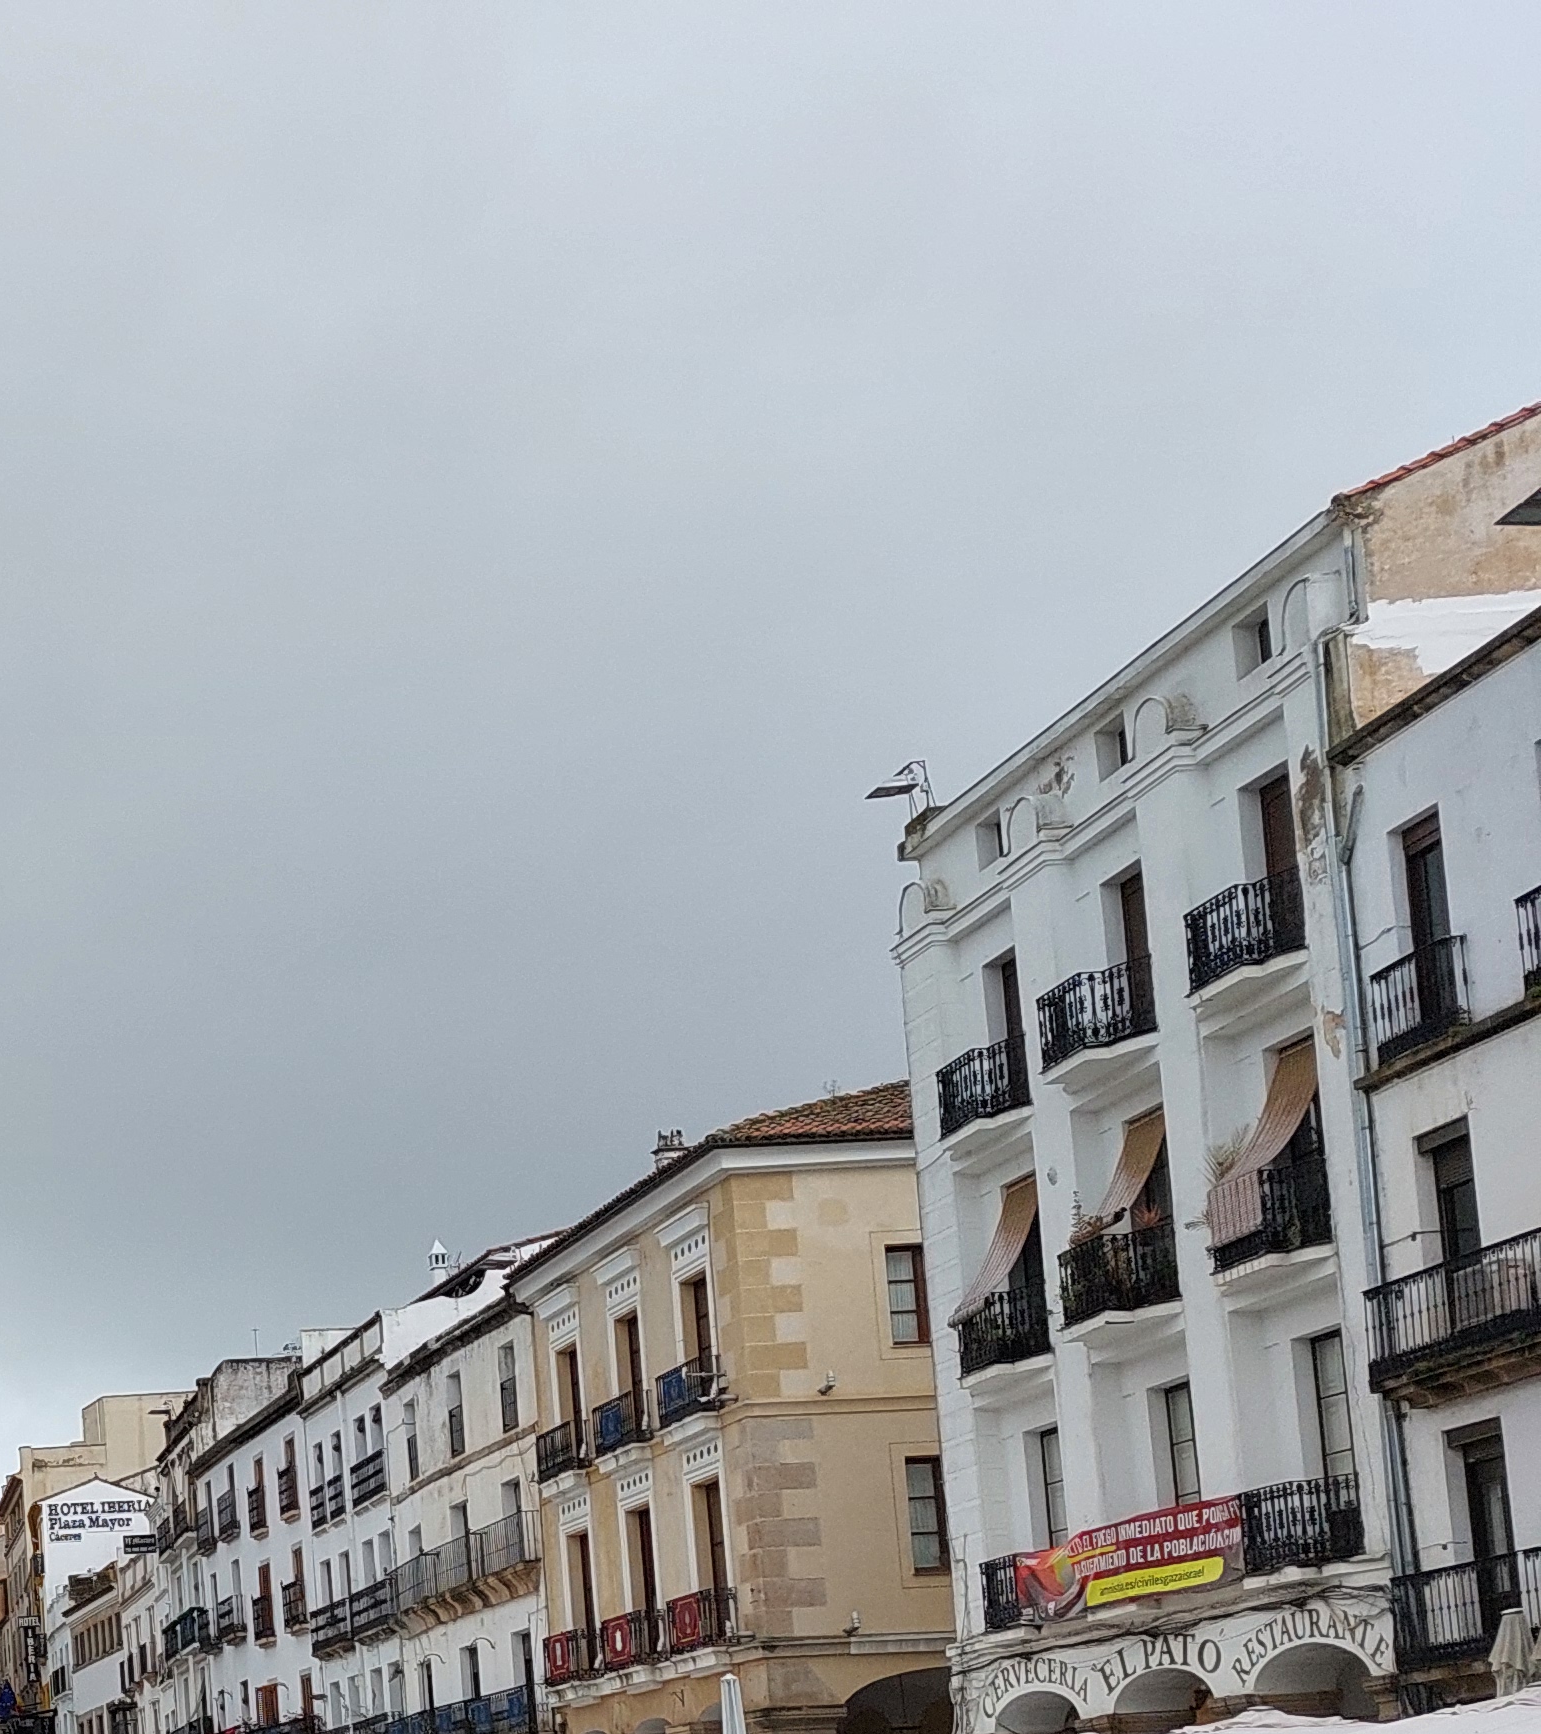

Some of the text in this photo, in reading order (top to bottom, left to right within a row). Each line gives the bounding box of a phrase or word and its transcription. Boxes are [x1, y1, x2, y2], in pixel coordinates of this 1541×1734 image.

[47, 1499, 151, 1516] HOTEL IBERIA
[48, 1516, 132, 1531] Plaza Mayor
[1092, 1527, 1116, 1549] FUEGO
[1117, 1514, 1174, 1541] INMEDIATO
[1178, 1510, 1200, 1531] QUE
[1129, 1545, 1145, 1564] DE
[1147, 1543, 1161, 1562] LA
[19, 1616, 40, 1627] HOTEL
[27, 1628, 36, 1681] IBERIA
[1230, 1608, 1389, 1689] RESTAURANTE
